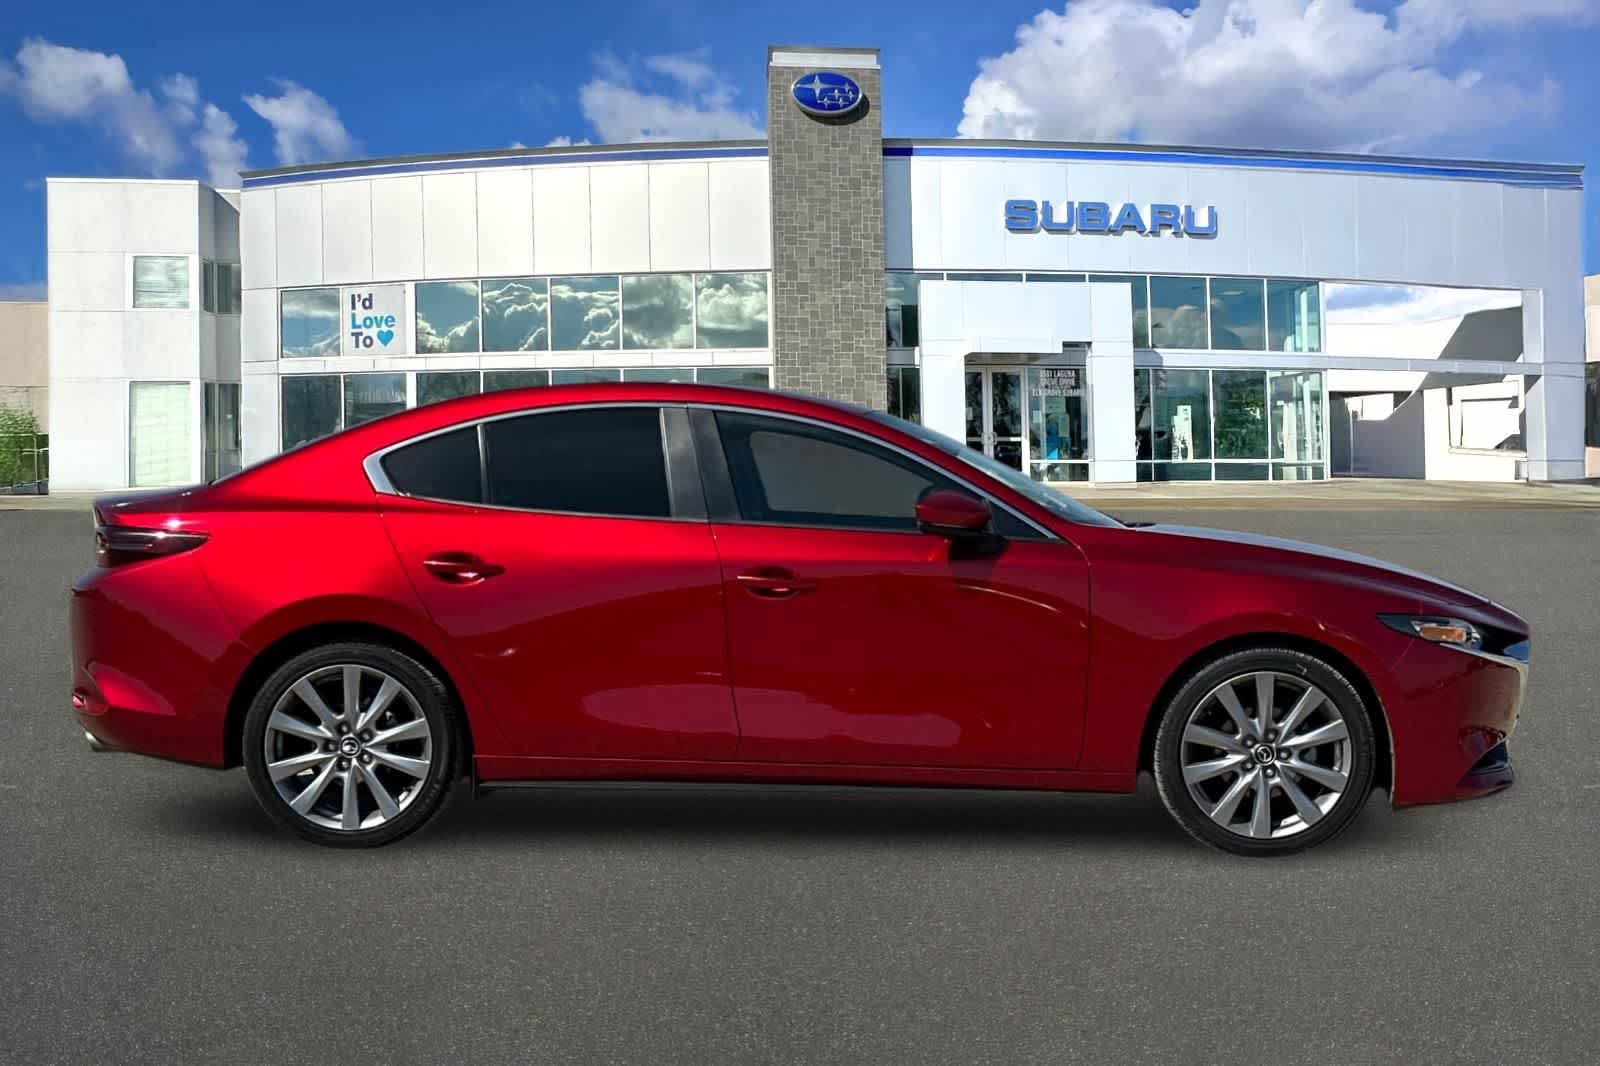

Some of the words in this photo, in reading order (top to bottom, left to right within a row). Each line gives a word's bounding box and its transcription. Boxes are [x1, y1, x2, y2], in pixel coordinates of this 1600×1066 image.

[1005, 199, 1218, 239] SUBARU
[351, 293, 373, 310] I’d
[351, 313, 396, 329] Love
[351, 331, 374, 348] To
